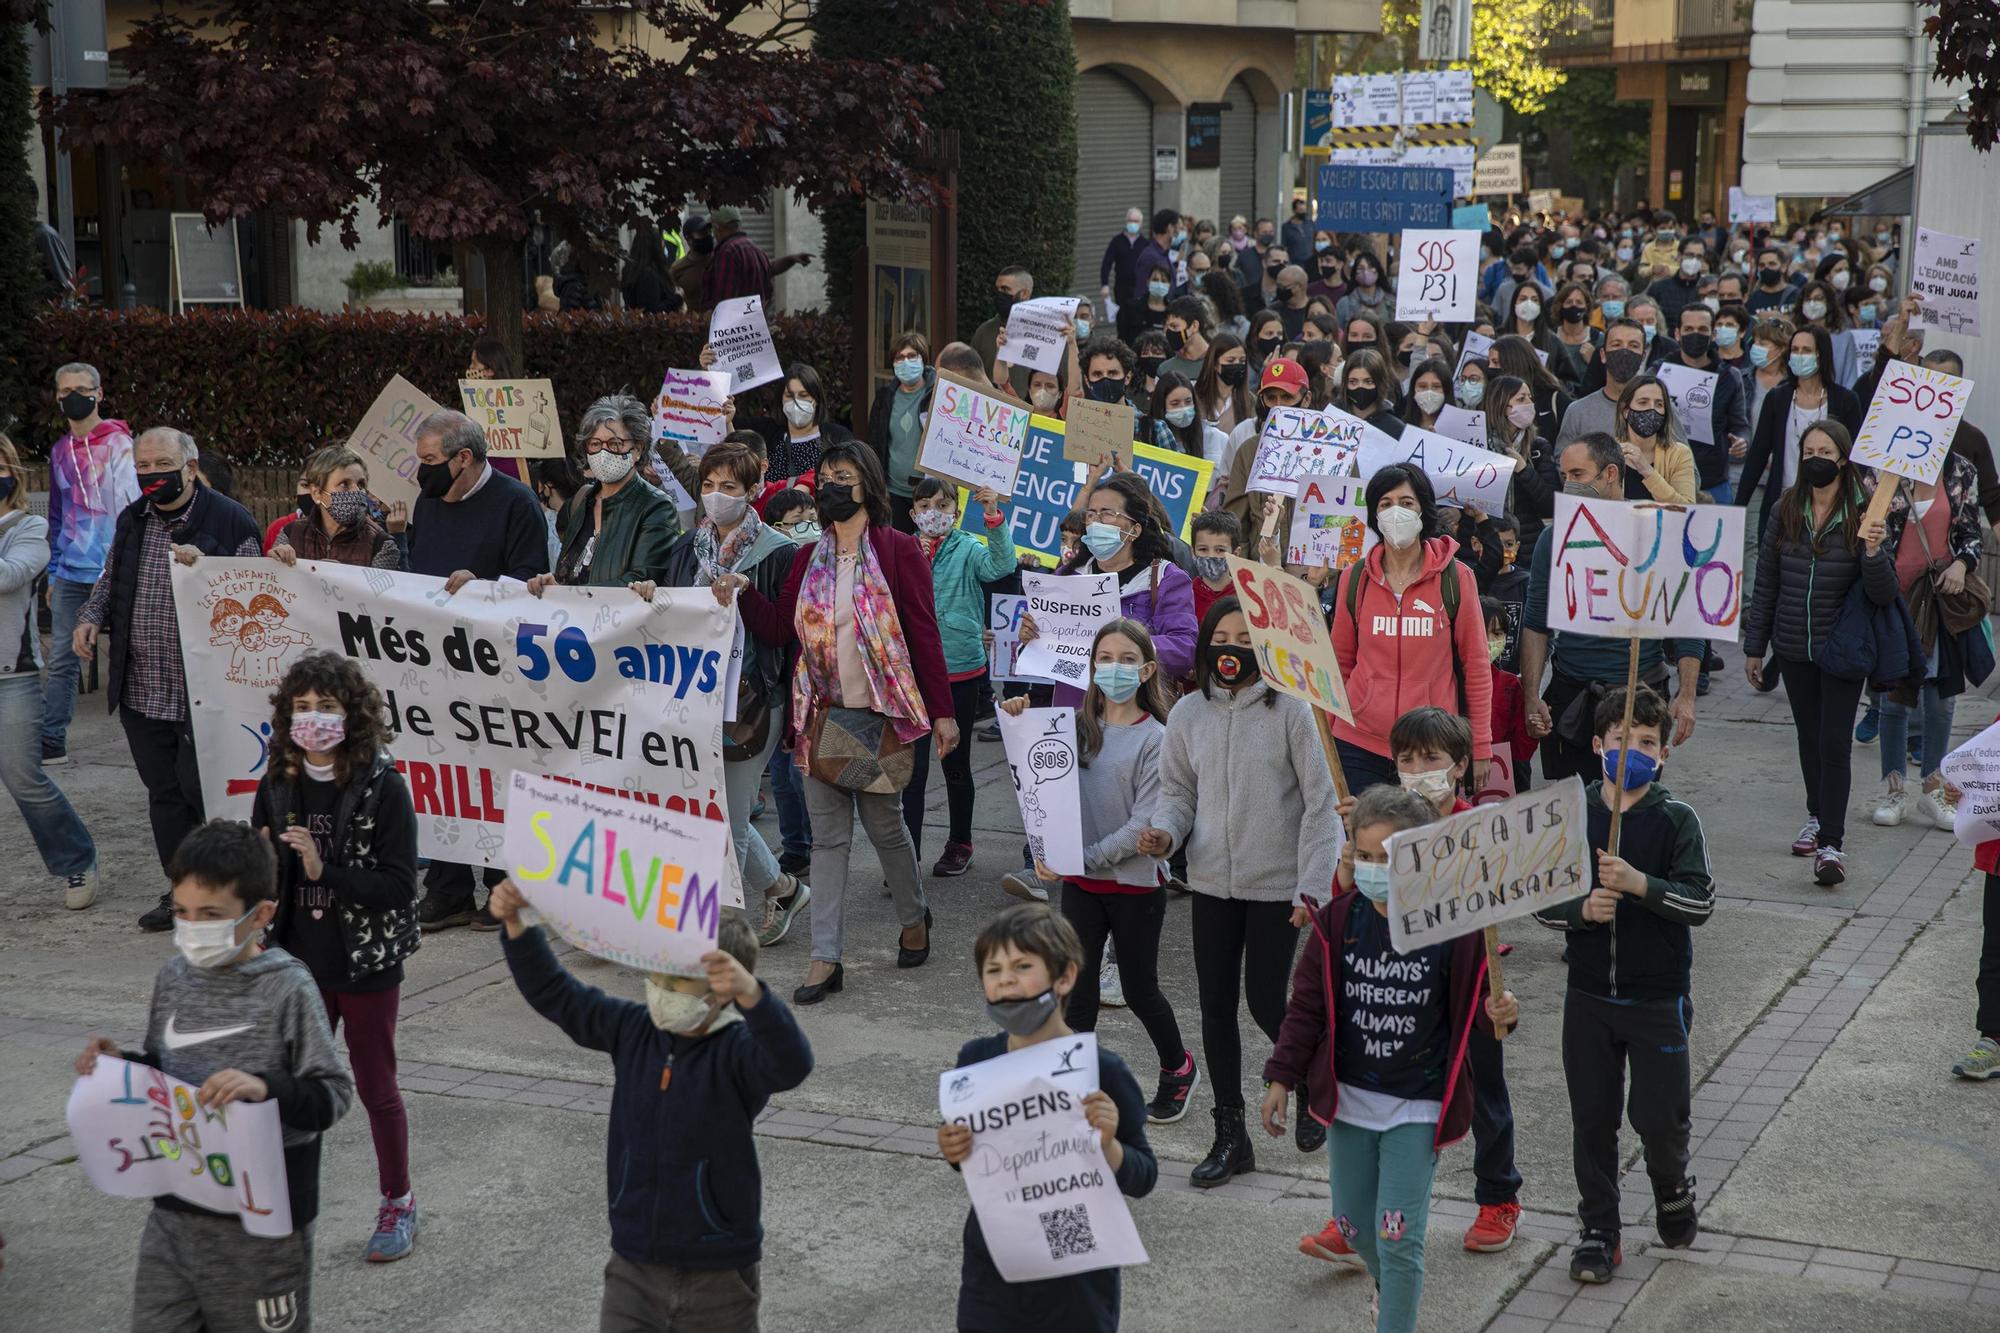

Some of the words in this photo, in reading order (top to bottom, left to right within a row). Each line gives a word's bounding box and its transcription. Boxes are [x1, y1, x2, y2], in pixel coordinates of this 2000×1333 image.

[1361, 171, 1399, 191] ESCOLA
[1409, 202, 1443, 224] JOSEP
[1411, 239, 1457, 273] SOS
[1935, 256, 1959, 269] AMB
[1918, 266, 1977, 286] L'EDUCACIÓ
[1420, 273, 1457, 308] P3!
[1913, 280, 1925, 291] NO
[1927, 283, 1945, 296] S'HI
[713, 325, 748, 338] TOCATS
[718, 338, 771, 358] DEPARTAMENT
[464, 385, 526, 408] TOCATS
[1888, 377, 1955, 419] SOS
[487, 408, 506, 424] DE
[942, 386, 1028, 438] SALVEM
[1886, 425, 1933, 459] P3
[1557, 502, 1723, 575] AJU
[208, 571, 232, 588] LLAR
[224, 581, 254, 596] CENT
[1030, 597, 1102, 617] SUSPENS
[1372, 615, 1434, 637] PUMA
[337, 610, 431, 667] Més
[442, 626, 501, 676] de
[516, 622, 597, 684] 50
[613, 643, 721, 701] anys
[225, 671, 249, 686] SANT
[383, 698, 435, 737] de
[449, 699, 627, 760] SERVEI
[641, 731, 700, 772] en
[1033, 750, 1068, 770] SOS
[1945, 764, 1960, 775] per
[1398, 797, 1563, 874] TOCATS
[516, 810, 720, 940] SALVEM
[1401, 861, 1583, 936] ENFONSATS
[1354, 957, 1423, 982] ALWAYS
[1345, 980, 1431, 1007] DIFFERENT
[1351, 1008, 1416, 1035] ALWAYS
[1364, 1038, 1393, 1059] ME
